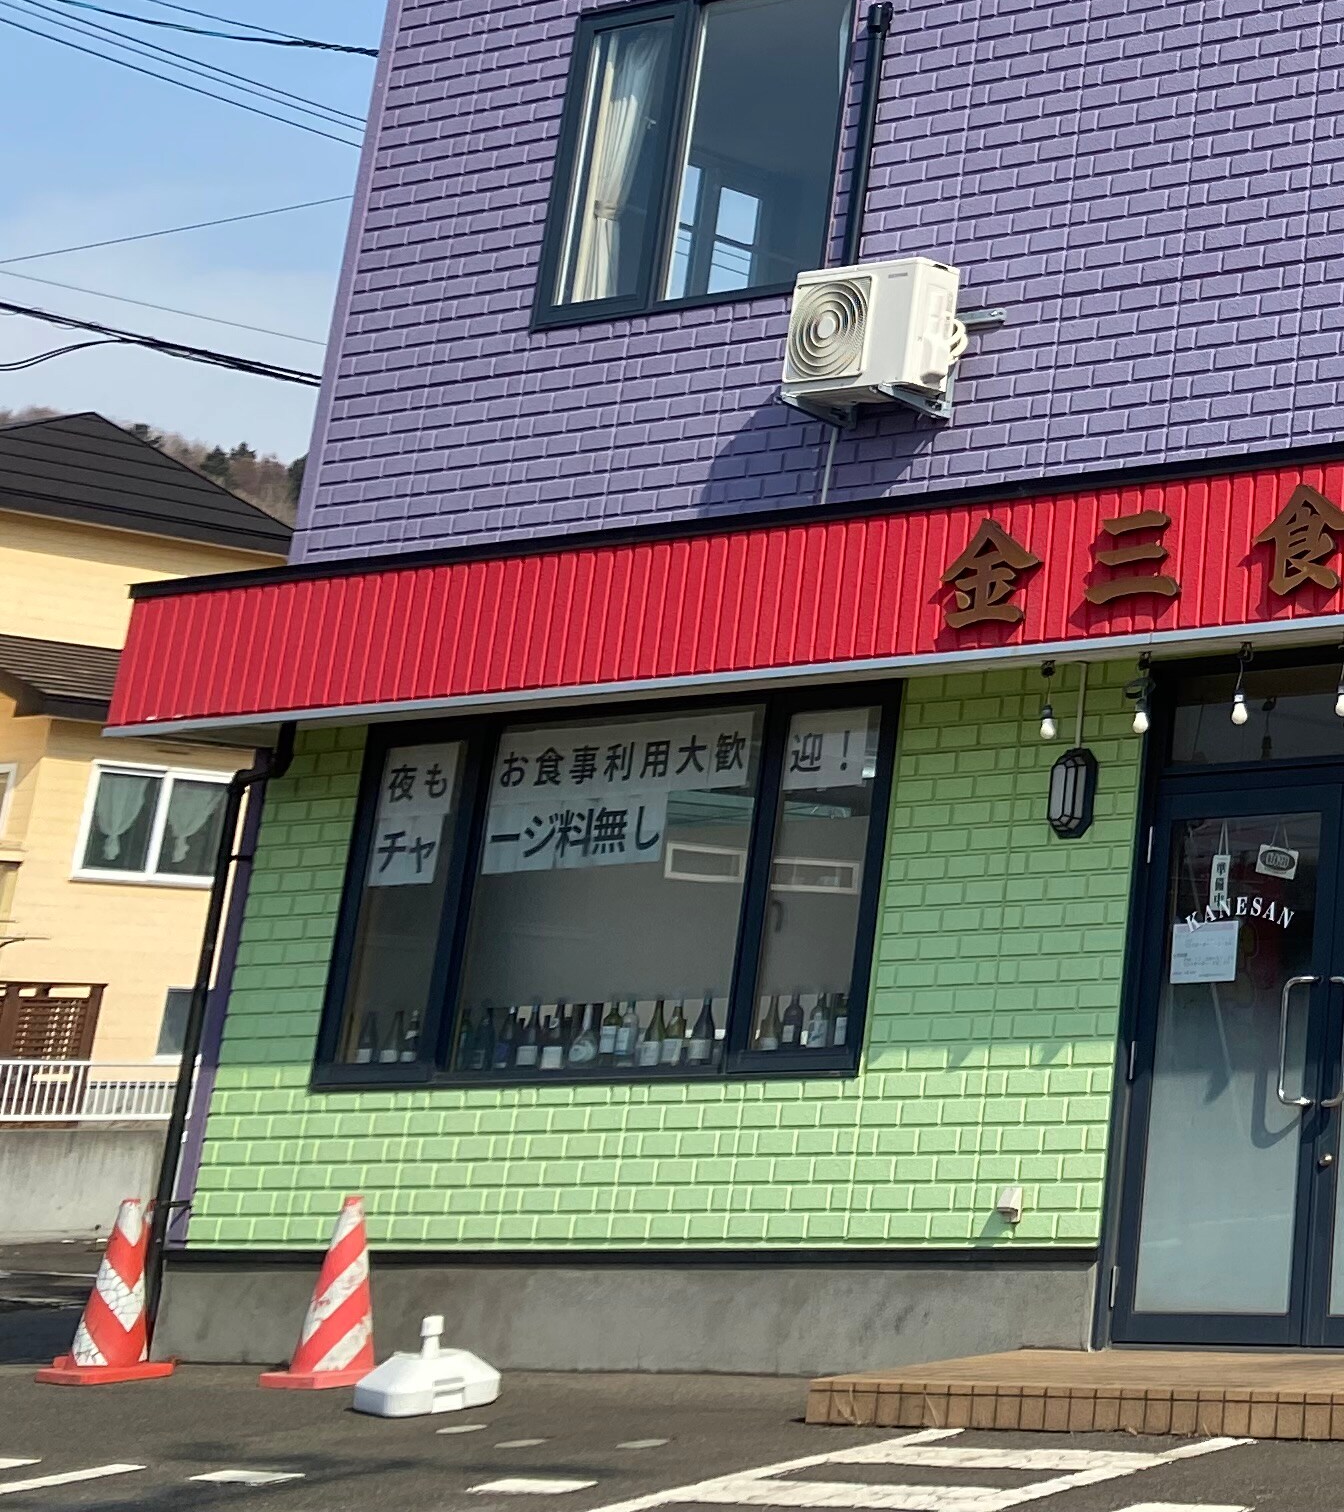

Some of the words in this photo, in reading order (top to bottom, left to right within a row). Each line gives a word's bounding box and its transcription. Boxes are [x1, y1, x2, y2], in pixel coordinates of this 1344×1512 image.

[388, 762, 448, 804] 夜も
[500, 730, 747, 788] お食事利用大歓
[376, 828, 437, 875] チャ
[489, 804, 661, 859] ージ料無し
[1185, 896, 1295, 933] KANESAN
